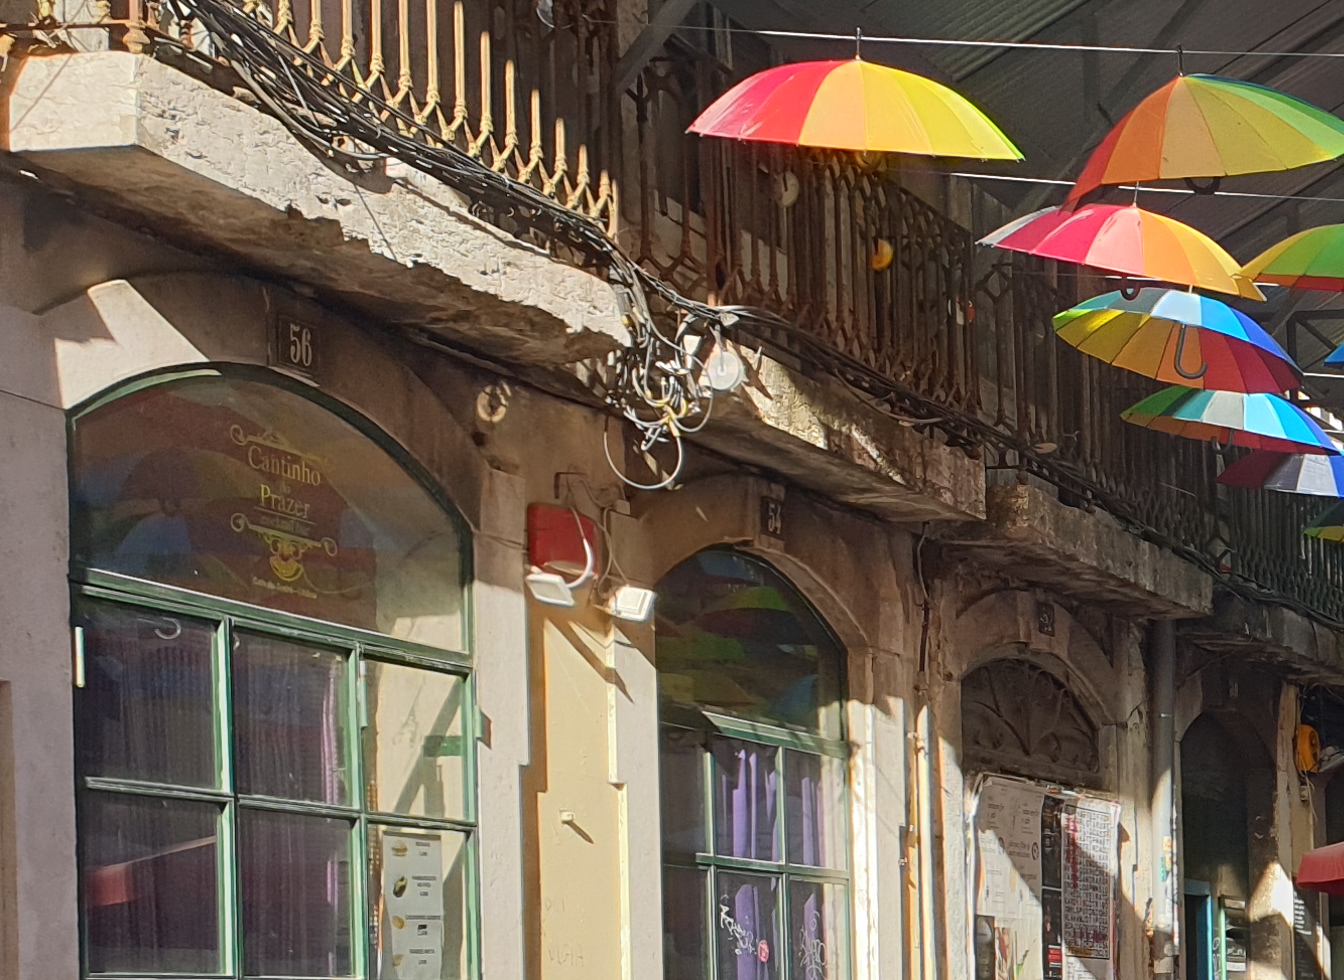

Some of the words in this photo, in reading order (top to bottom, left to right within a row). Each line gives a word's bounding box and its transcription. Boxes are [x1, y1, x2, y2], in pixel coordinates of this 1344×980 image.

[289, 322, 313, 367] 56
[248, 445, 321, 486] Cantinho
[260, 484, 311, 518] Prazer
[767, 500, 782, 534] 54
